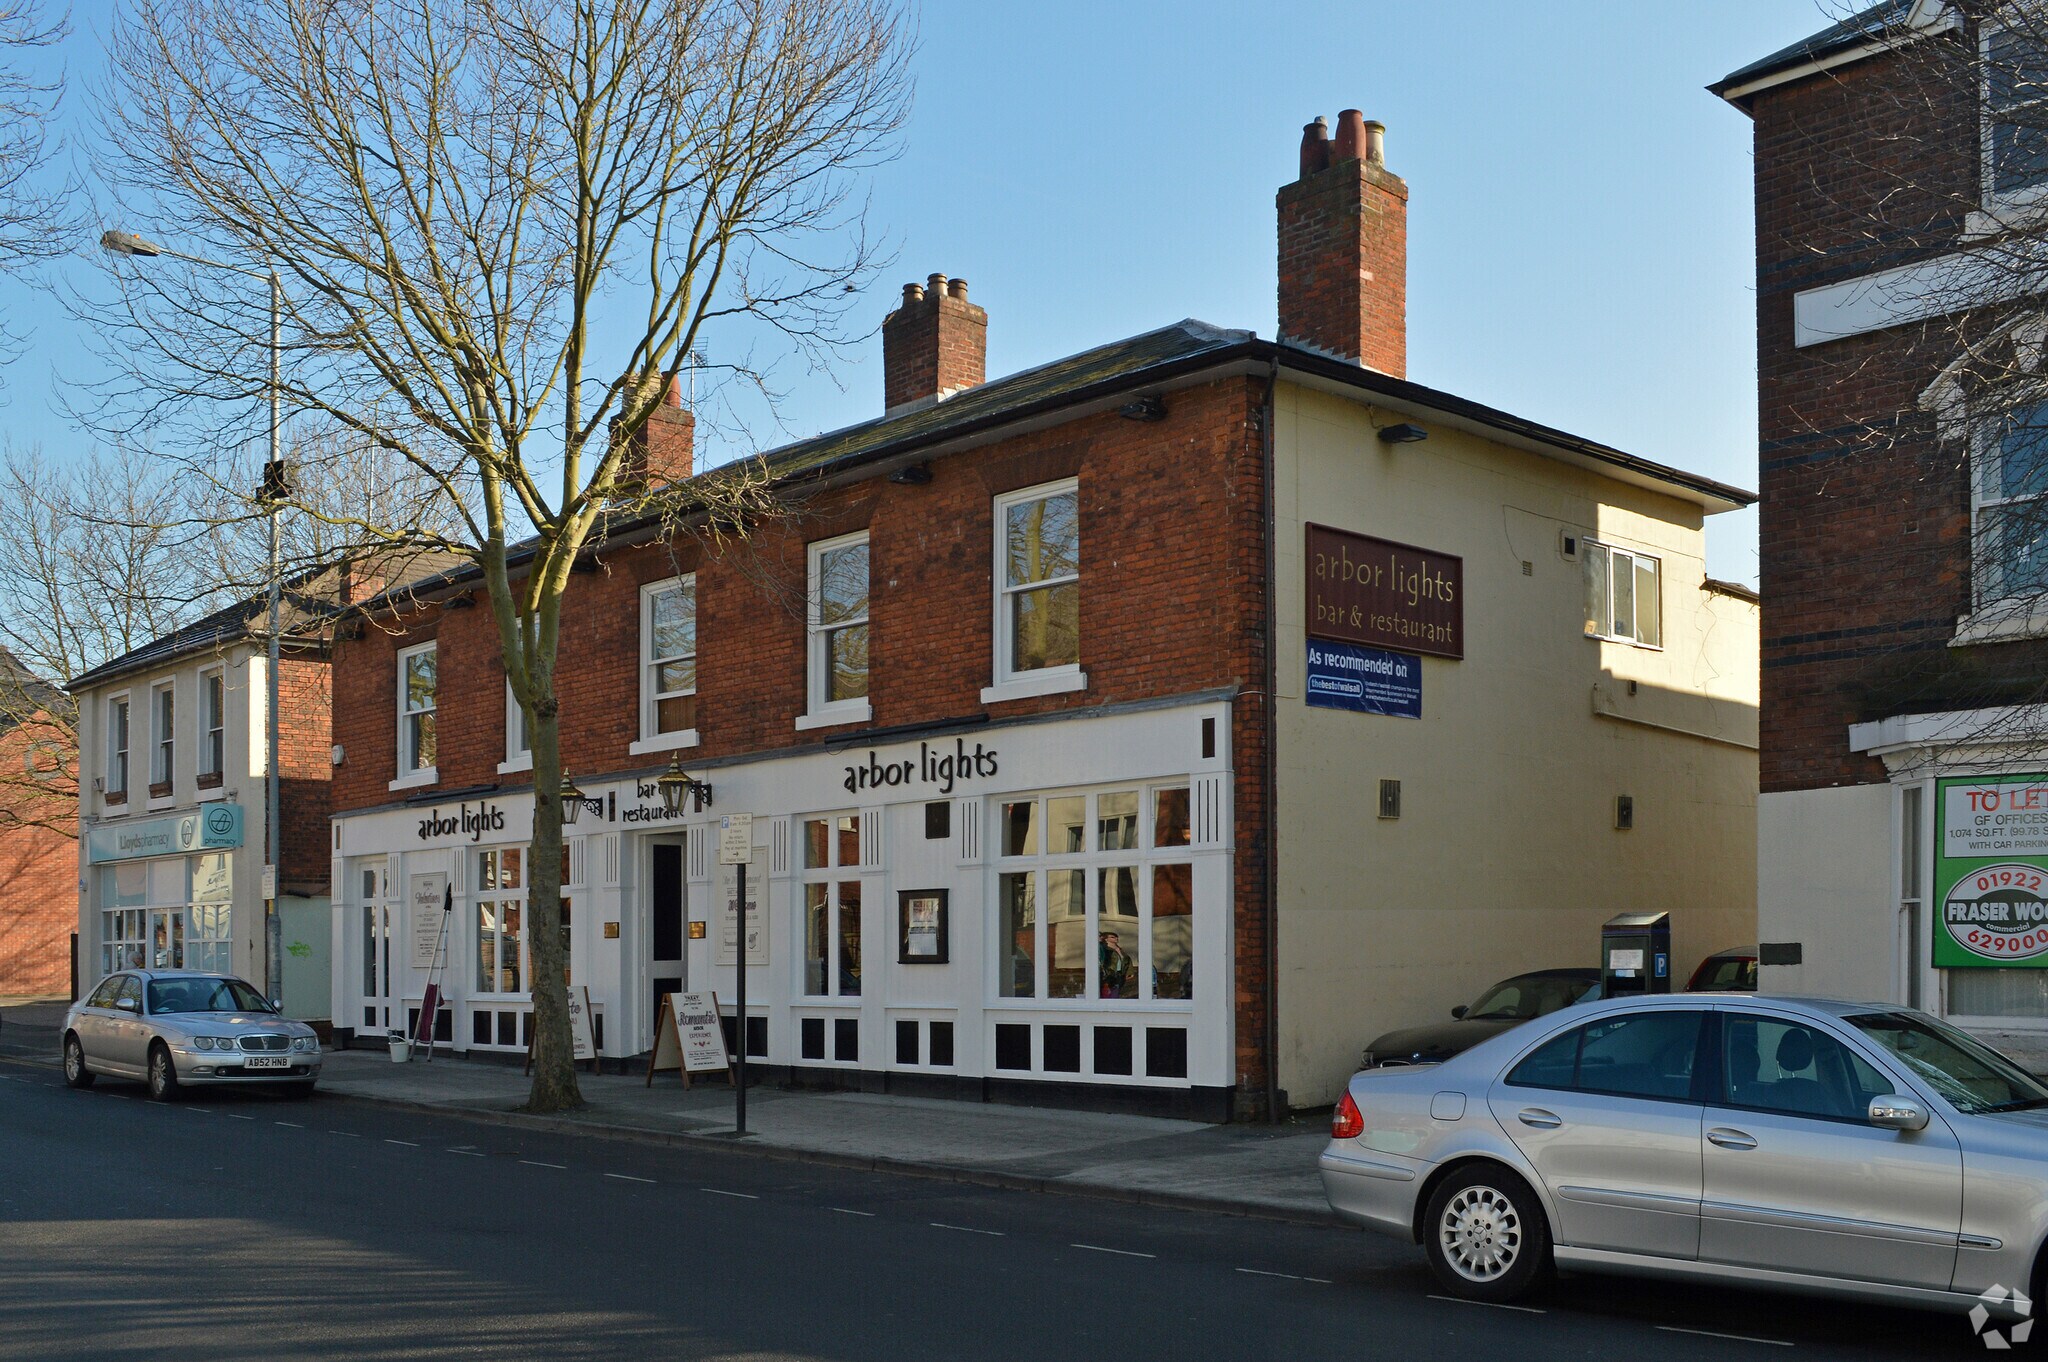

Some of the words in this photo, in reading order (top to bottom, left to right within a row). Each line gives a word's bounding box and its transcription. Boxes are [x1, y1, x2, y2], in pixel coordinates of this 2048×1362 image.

[1316, 545, 1383, 587] arbor
[1392, 555, 1454, 606] lights
[1317, 595, 1345, 625] bar
[1350, 605, 1363, 629] &
[1370, 612, 1453, 643] restaurant
[1309, 648, 1322, 665] As
[1324, 653, 1393, 676] recommended
[1396, 664, 1408, 678] on
[844, 751, 914, 793] arbor
[921, 738, 998, 793] lights
[636, 778, 656, 799] bar
[1966, 790, 2001, 812] TO
[418, 809, 458, 841] arbor
[461, 802, 504, 842] lights
[1974, 815, 1991, 826] GF
[119, 832, 170, 852] Lloydspharmacy
[204, 837, 236, 847] pharmacy
[1949, 829, 1972, 839] 1,074
[1975, 828, 2007, 838] SQ.FT.
[2010, 826, 2040, 837] (99.78
[1969, 842, 1991, 850] WITH
[1993, 841, 2012, 849] CAR
[2014, 839, 2048, 848] PARKIN
[1977, 871, 2042, 891] 01922
[1948, 902, 2010, 921] FRASER
[2014, 901, 2048, 921] WO
[1985, 922, 2031, 933] commercial
[1967, 929, 2048, 952] 629000
[1658, 957, 1665, 973] P
[271, 1058, 288, 1067] HNB
